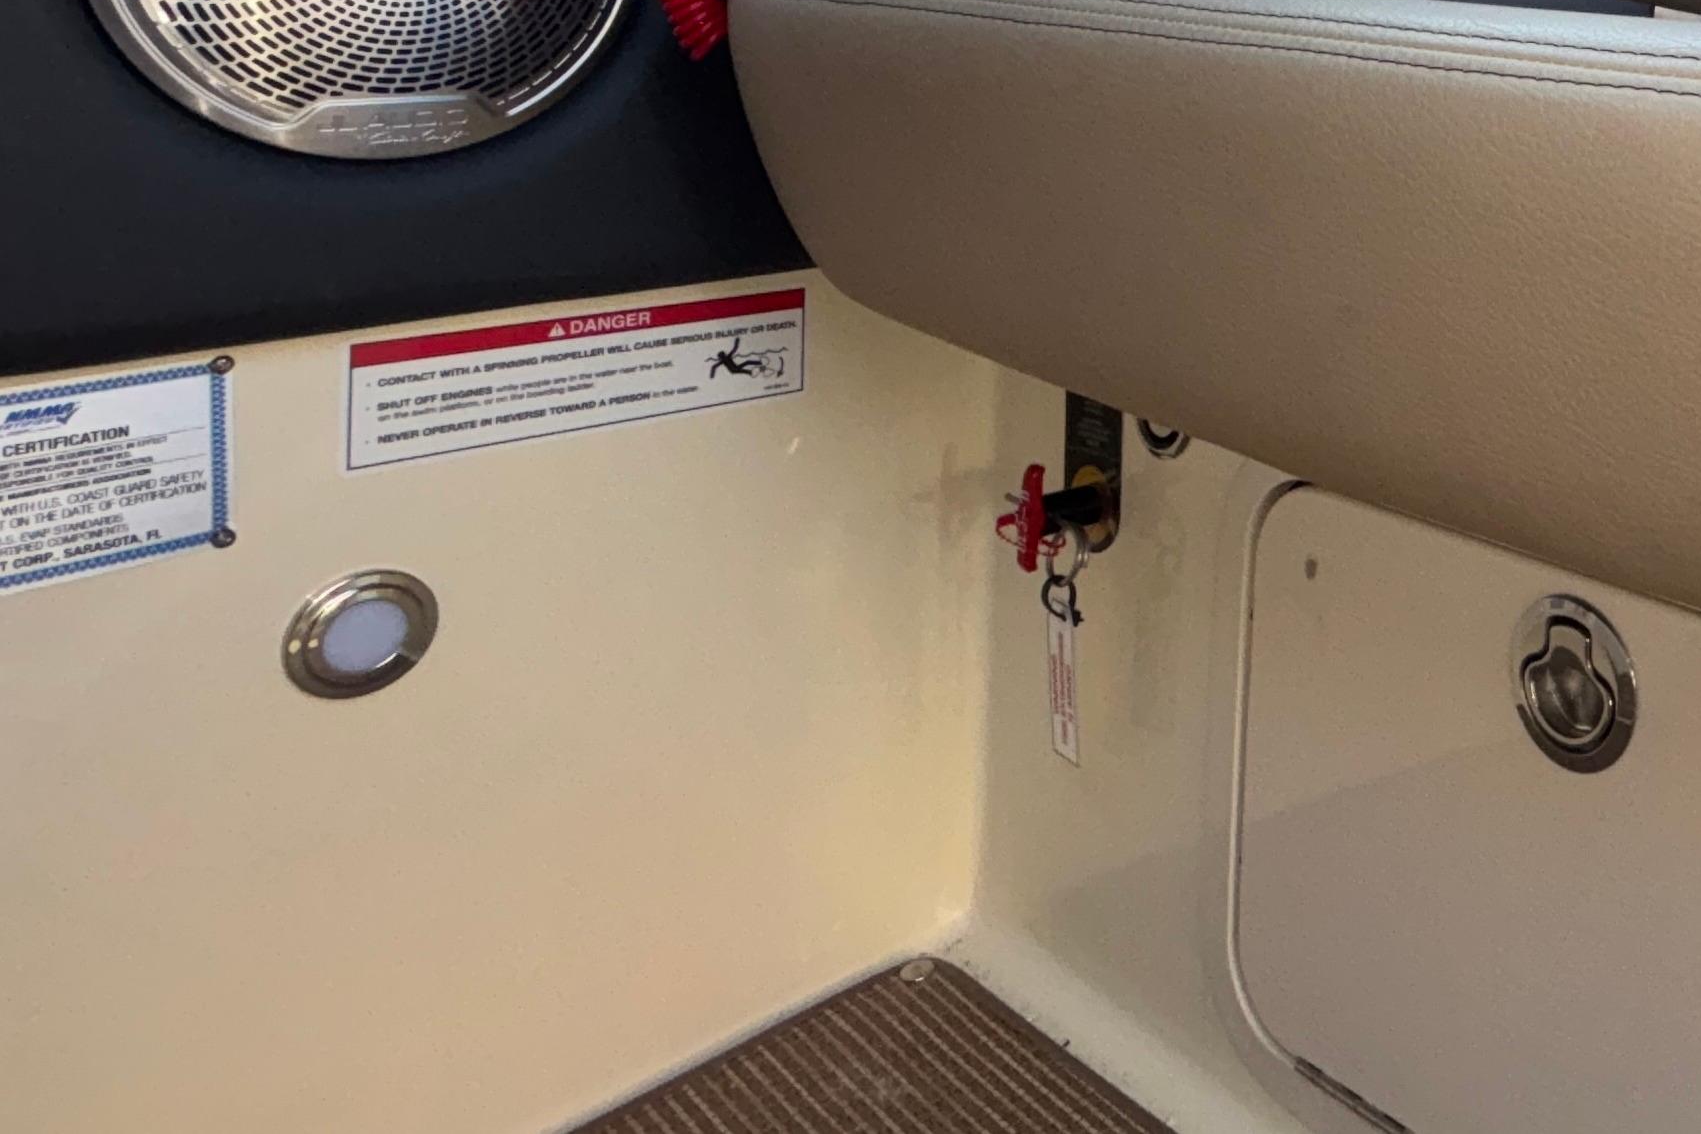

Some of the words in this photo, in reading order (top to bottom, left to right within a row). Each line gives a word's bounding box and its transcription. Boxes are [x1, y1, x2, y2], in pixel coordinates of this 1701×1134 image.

[570, 311, 651, 334] DANGER
[377, 371, 435, 387] CONTACT
[440, 366, 469, 378] WITH
[473, 364, 482, 373] A
[541, 347, 604, 363] PROPELLER
[607, 343, 632, 354] WILL
[633, 339, 667, 350] CAUSE
[671, 332, 712, 345] SERIOUS
[715, 327, 748, 338] INJURY
[750, 325, 764, 333] OR
[376, 398, 410, 411] SHUT
[414, 394, 436, 405] OFF
[441, 386, 492, 401] ENGINES
[376, 430, 418, 444] NEVER
[422, 420, 477, 436] OPERATE
[480, 417, 492, 427] IN
[495, 408, 546, 424] REVERSE
[549, 400, 596, 415] TOWARD
[598, 399, 606, 407] A
[608, 391, 650, 405] PERSON
[2, 425, 130, 457] CERTIFICATION
[1, 503, 33, 517] WITH
[37, 497, 62, 510] U.S.
[67, 488, 108, 504] COAST
[113, 478, 156, 495] GUARD
[159, 469, 203, 485] SAFETY
[9, 516, 28, 529] ON
[34, 511, 56, 524] THE
[61, 503, 94, 518] DATE
[99, 499, 114, 510] OF
[119, 480, 206, 506] CERTIFICATION
